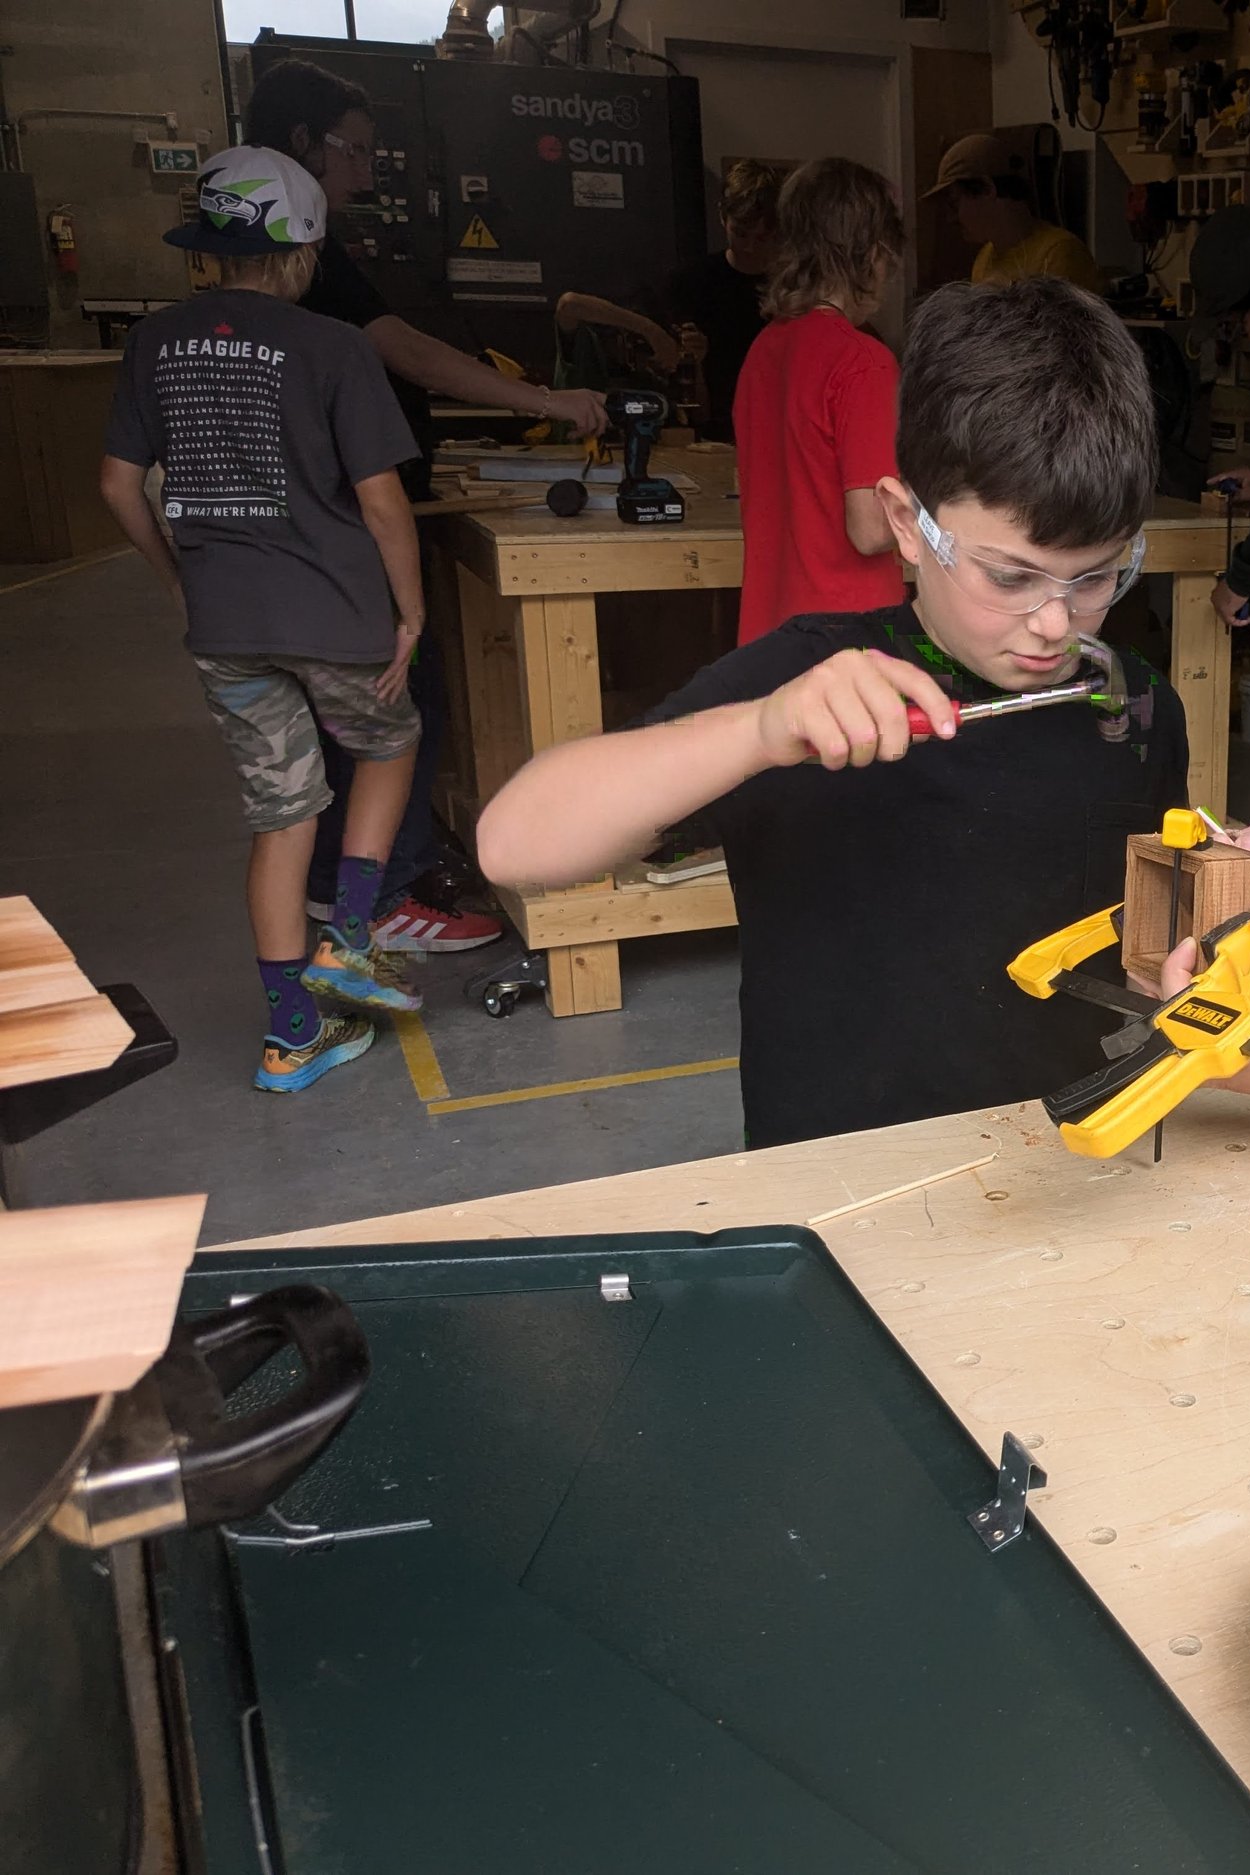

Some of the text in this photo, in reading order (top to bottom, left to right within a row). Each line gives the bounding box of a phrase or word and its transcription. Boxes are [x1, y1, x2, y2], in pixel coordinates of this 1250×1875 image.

[568, 136, 645, 166] scm
[158, 339, 285, 366] A LEAGUE OF
[187, 506, 212, 517] WHAT
[213, 506, 246, 517] WE'RE
[249, 506, 279, 517] MADE
